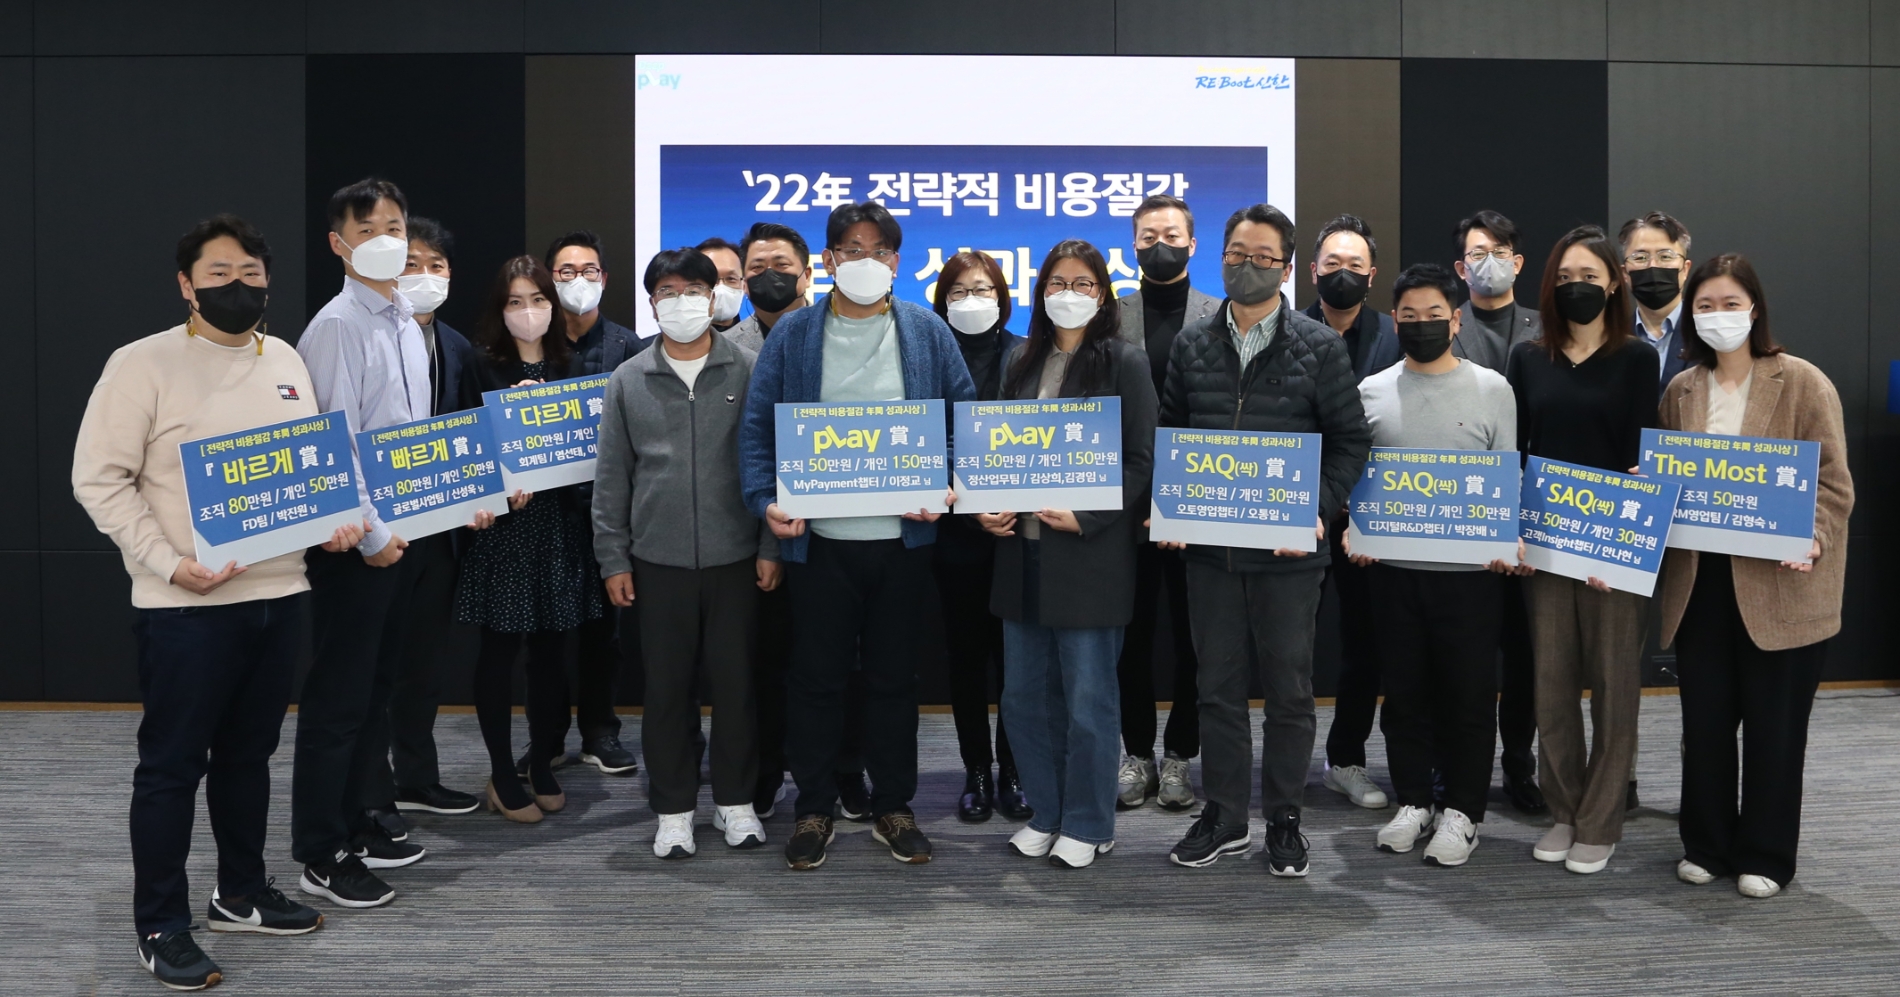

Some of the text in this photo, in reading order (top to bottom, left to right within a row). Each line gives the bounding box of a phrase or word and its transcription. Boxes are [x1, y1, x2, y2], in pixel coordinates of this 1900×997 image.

[867, 172, 999, 216] 전략적
[506, 391, 529, 402] 전략적
[531, 386, 561, 397] 비용절감
[520, 399, 582, 426] 다르게
[800, 408, 826, 418] 전략적
[829, 407, 864, 417] 비용절감
[886, 405, 920, 415] 성과시상
[977, 405, 1002, 415] 전략적
[1005, 405, 1039, 414] 비용절감
[1061, 403, 1095, 412] 성과시상
[206, 442, 234, 453] 전략적
[236, 432, 270, 448] 비용절감
[291, 421, 324, 436] 성과시상
[377, 430, 399, 442] 전략적
[400, 425, 429, 437] 비용절감
[446, 416, 473, 428] 성과시상
[501, 440, 523, 454] 조직
[526, 432, 564, 449] 80만원
[573, 427, 594, 440] 개인
[1178, 434, 1203, 444] 전략적
[1205, 435, 1239, 445] 비용절감
[1261, 437, 1296, 448] 성과시상
[1664, 436, 1691, 446] 전략적
[1694, 438, 1730, 450] 비용절감
[1753, 443, 1791, 455] 성과시상
[390, 438, 449, 470] 빠르게
[519, 453, 547, 467] 회계팀
[779, 455, 943, 473] 조직 50만원 개인 150만원
[956, 452, 1118, 469] 조직 50만원 개인 150만원
[1374, 452, 1400, 462] 전략적
[1402, 453, 1437, 463] 비용절감
[1459, 454, 1494, 465] 성과시상
[222, 448, 294, 485] 바르게
[1185, 452, 1258, 480] SAQ(싹)
[1654, 454, 1697, 477] The
[1705, 458, 1768, 484] Most
[373, 461, 495, 501] 조직 80만원 개인 50만원
[794, 477, 879, 492] MyPayment챕터
[890, 475, 921, 486] 이정교
[968, 473, 1020, 485] 정산업무팀
[1383, 470, 1457, 497] SAQ(싹)
[1547, 464, 1569, 477] 전략적
[1571, 469, 1603, 484] 비용절감
[1622, 479, 1655, 493] 성과시상
[200, 472, 349, 521] 조직 80만원 개인 50만원
[393, 493, 444, 515] 글로벌사업팀
[1159, 484, 1309, 505] 조직 50만원 개인 30만원
[1547, 483, 1615, 516] SAQ(싹)
[1682, 490, 1758, 510] 조직 50만원
[242, 504, 317, 531] FD팀 박진원 님
[1176, 504, 1238, 518] 오토영업챕터
[1282, 513, 1289, 521] 님
[1356, 501, 1510, 521] 조직 50만원 개인 30만원
[1732, 514, 1766, 529] 김형숙
[1769, 521, 1777, 529] 님
[1369, 520, 1444, 535] 디지털R&D챕터
[1490, 528, 1497, 536] 님
[1519, 508, 1658, 551] 조직 50만원 개인 30만원
[1523, 528, 1594, 554] 고객Insight챕터
